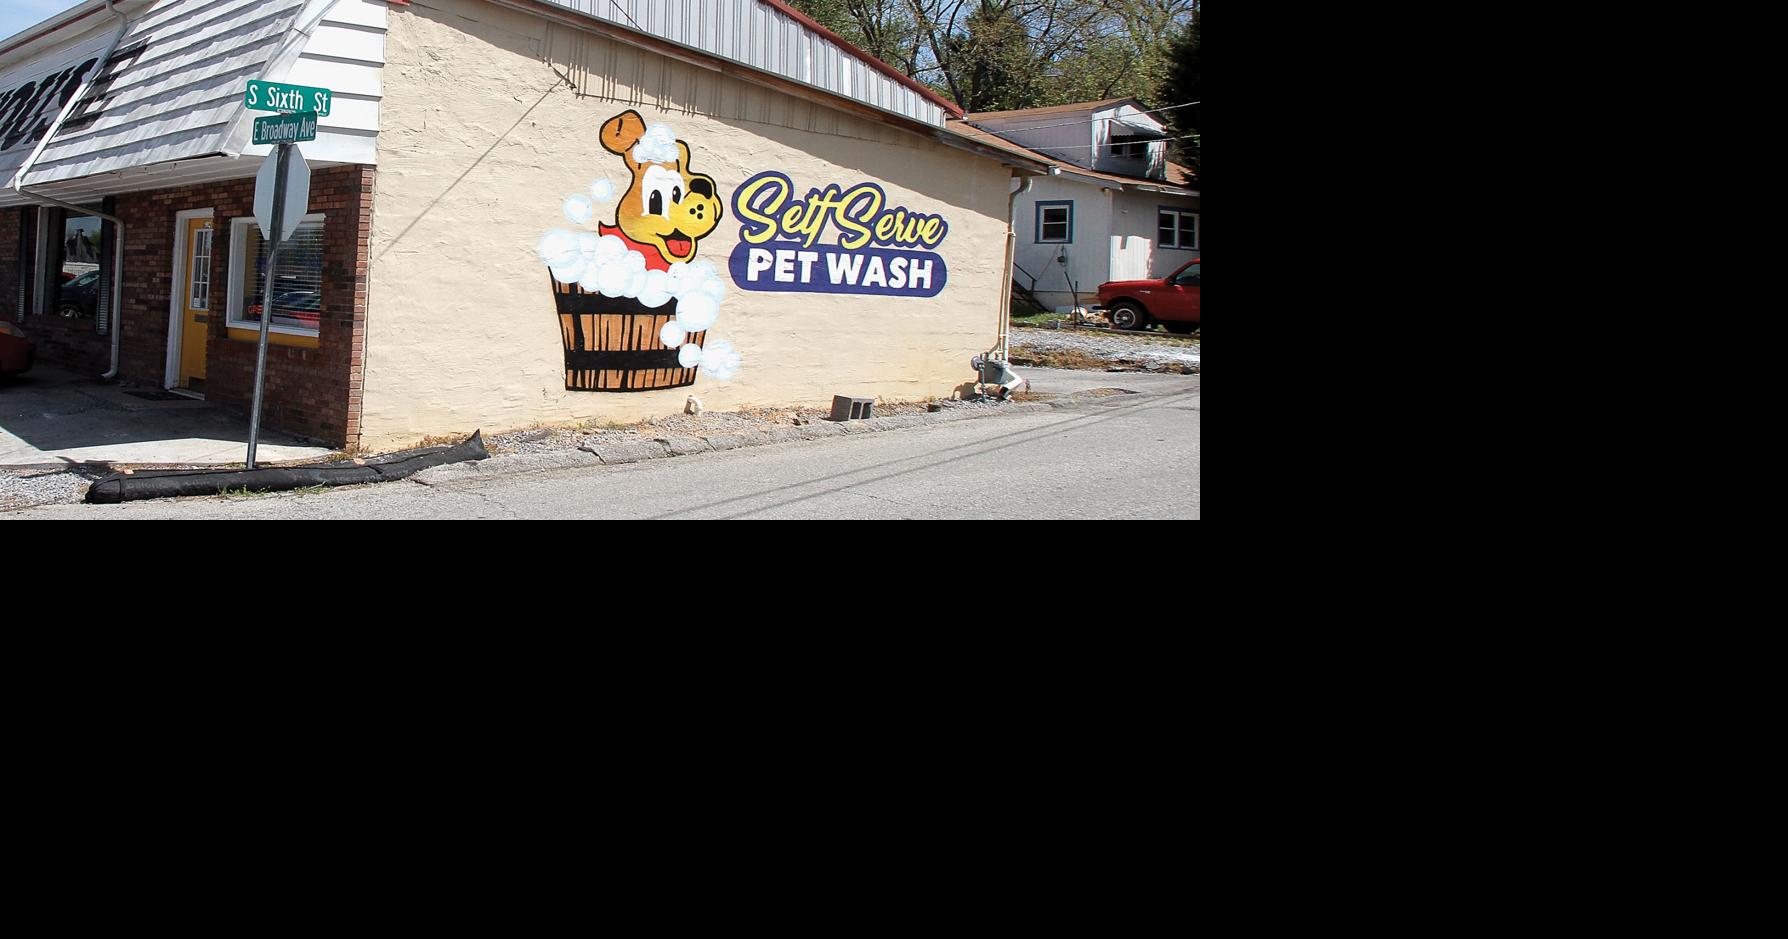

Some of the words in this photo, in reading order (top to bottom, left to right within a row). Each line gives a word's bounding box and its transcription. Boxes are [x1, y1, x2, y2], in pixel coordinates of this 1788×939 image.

[248, 84, 258, 105] S
[266, 86, 303, 110] Sixth
[313, 92, 328, 112] St
[253, 121, 260, 141] E
[261, 120, 299, 141] Broadway
[300, 117, 316, 138] Ave
[737, 176, 842, 249] Self
[834, 186, 945, 250] Serve
[747, 248, 818, 283] PET
[826, 252, 934, 289] WASH
[247, 303, 264, 314] OPE
